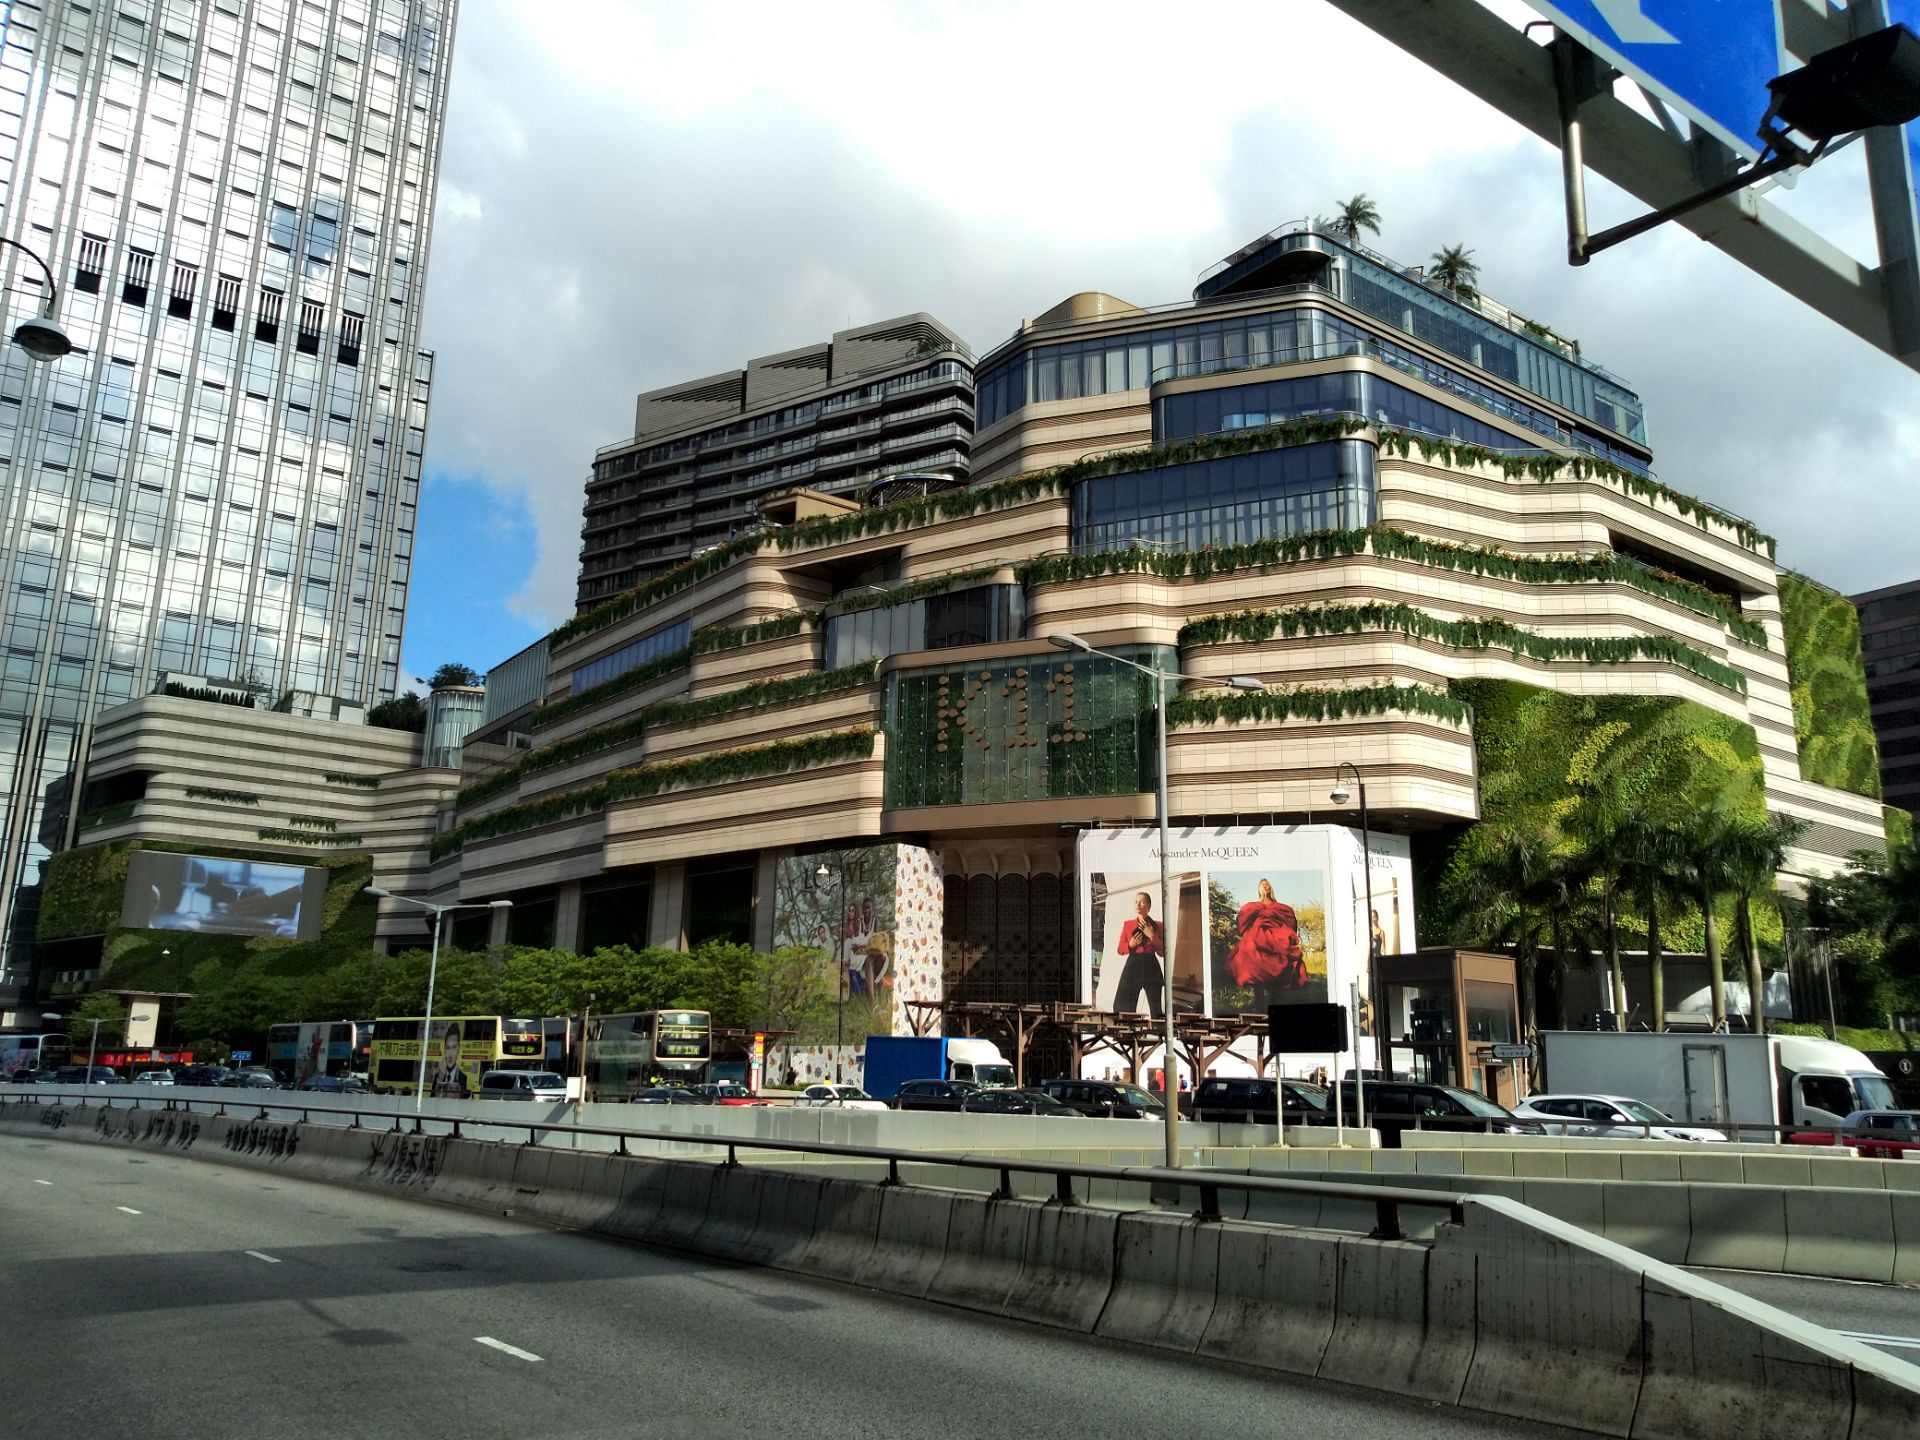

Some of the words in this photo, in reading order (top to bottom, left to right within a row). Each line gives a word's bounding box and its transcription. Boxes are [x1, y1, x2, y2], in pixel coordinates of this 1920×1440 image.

[936, 663, 1086, 753] K11
[1148, 847, 1199, 858] Alxander
[1200, 846, 1259, 860] McQUEEN
